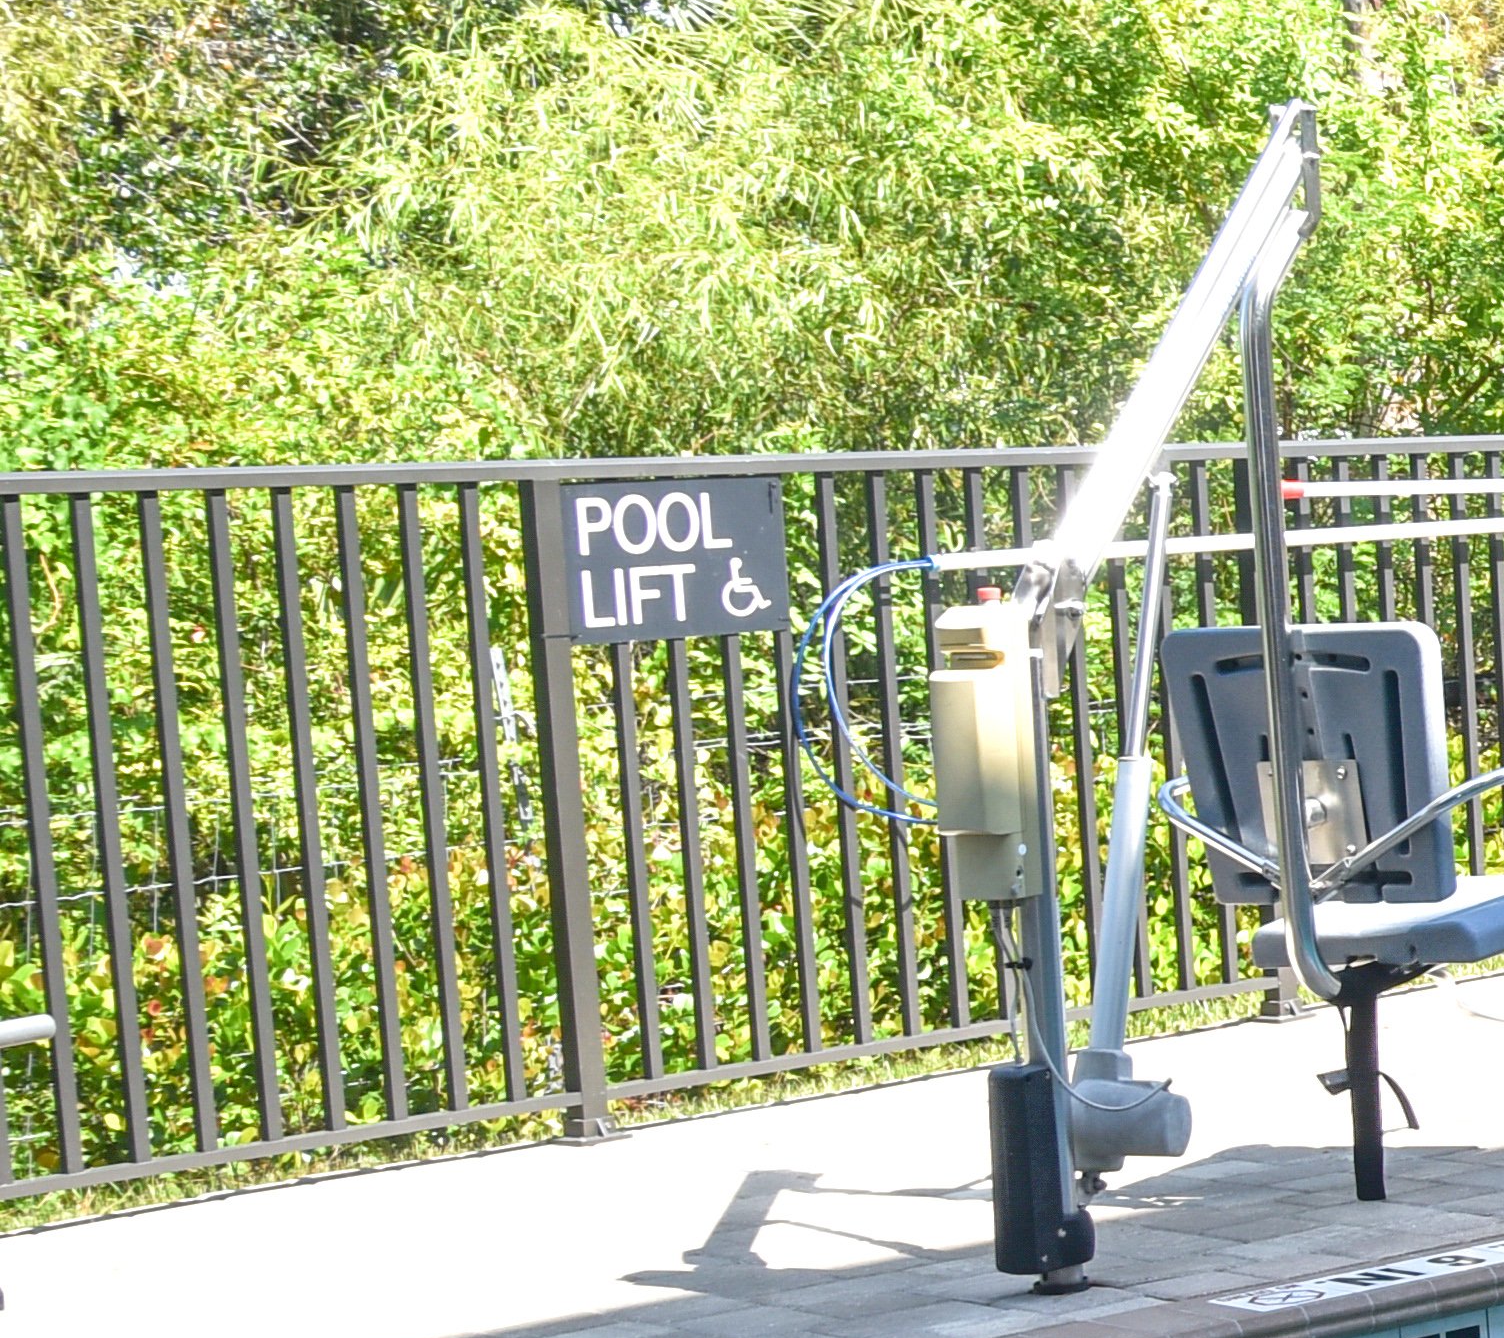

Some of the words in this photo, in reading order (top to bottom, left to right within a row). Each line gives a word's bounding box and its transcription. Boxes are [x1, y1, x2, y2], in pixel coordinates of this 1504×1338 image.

[575, 492, 733, 557] POOL
[581, 564, 696, 629] LIFT
[1426, 1254, 1488, 1268] 6
